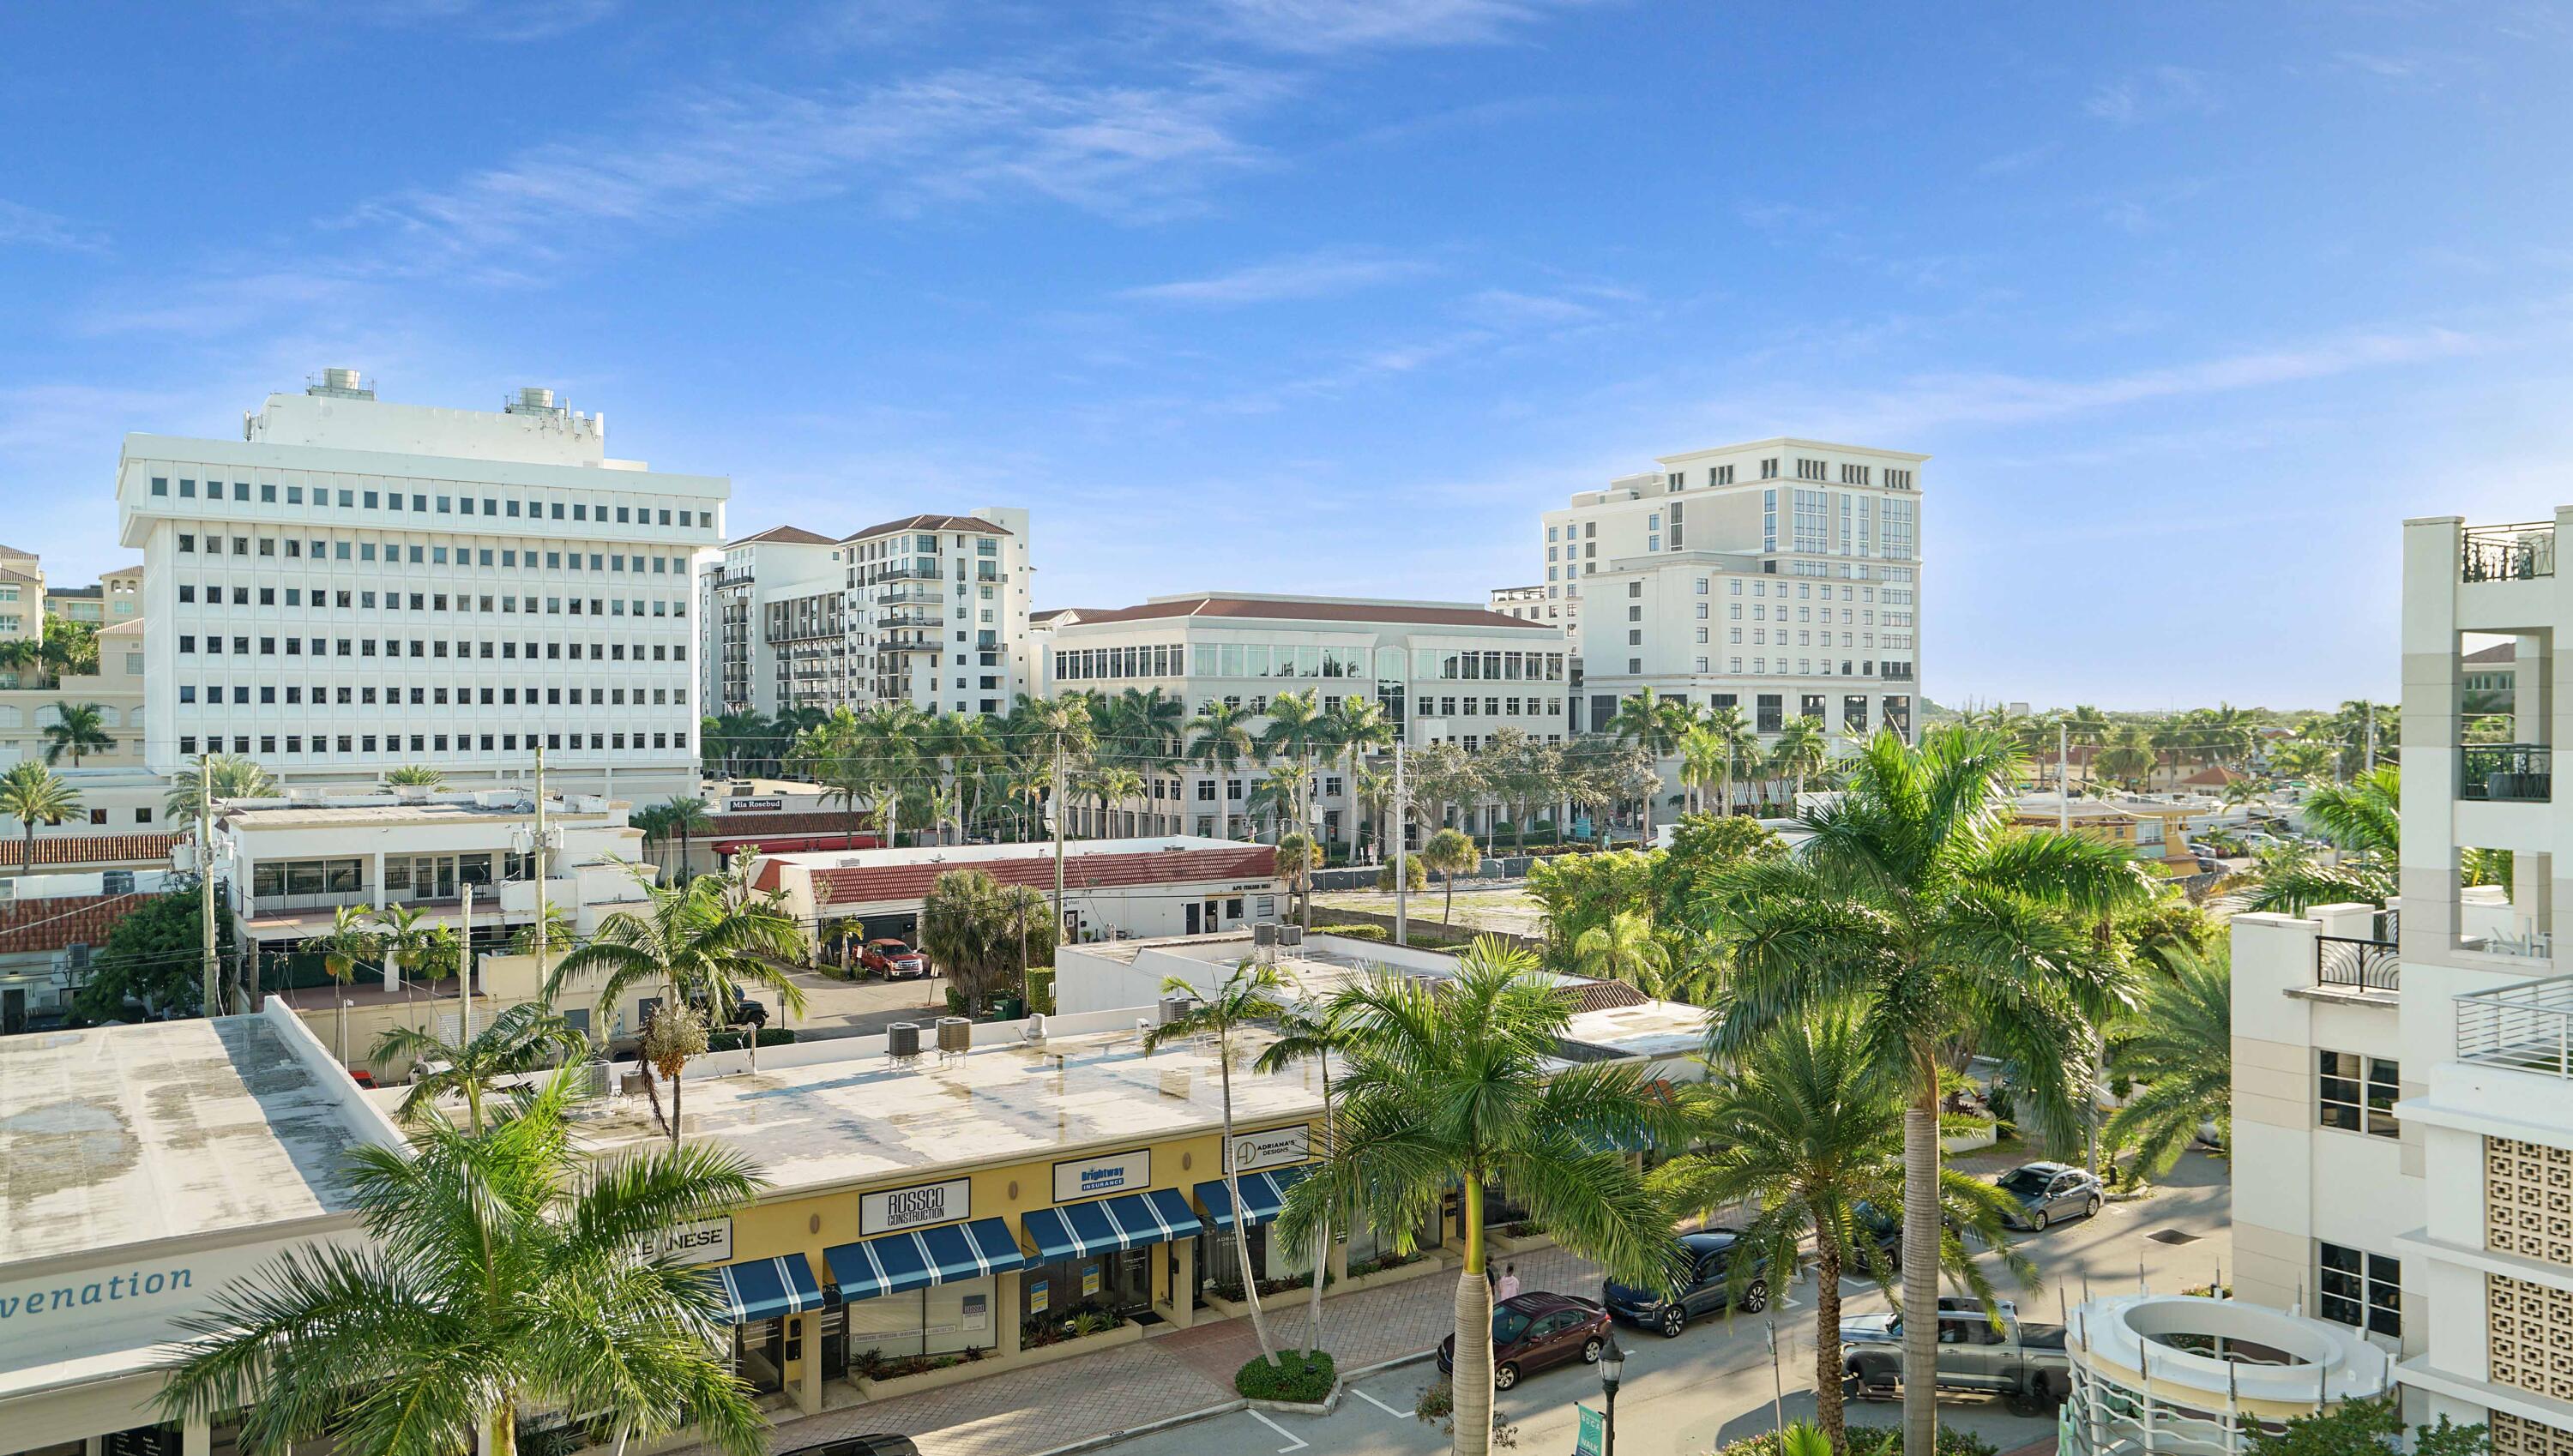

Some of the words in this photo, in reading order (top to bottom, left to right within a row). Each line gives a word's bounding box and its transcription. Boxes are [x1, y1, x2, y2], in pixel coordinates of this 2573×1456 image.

[1257, 1139, 1296, 1151] ADRIANA'S
[1263, 1147, 1289, 1156] DESIGNS
[1082, 1166, 1124, 1181] Brightway
[1083, 1179, 1124, 1190] INSURANCE
[889, 1187, 944, 1214] ROSSCO
[888, 1206, 944, 1226] CONSTRUCTION
[0, 1268, 192, 1318] venation
[1582, 1413, 1600, 1430] BOCA
[1581, 1436, 1599, 1453] WALK
